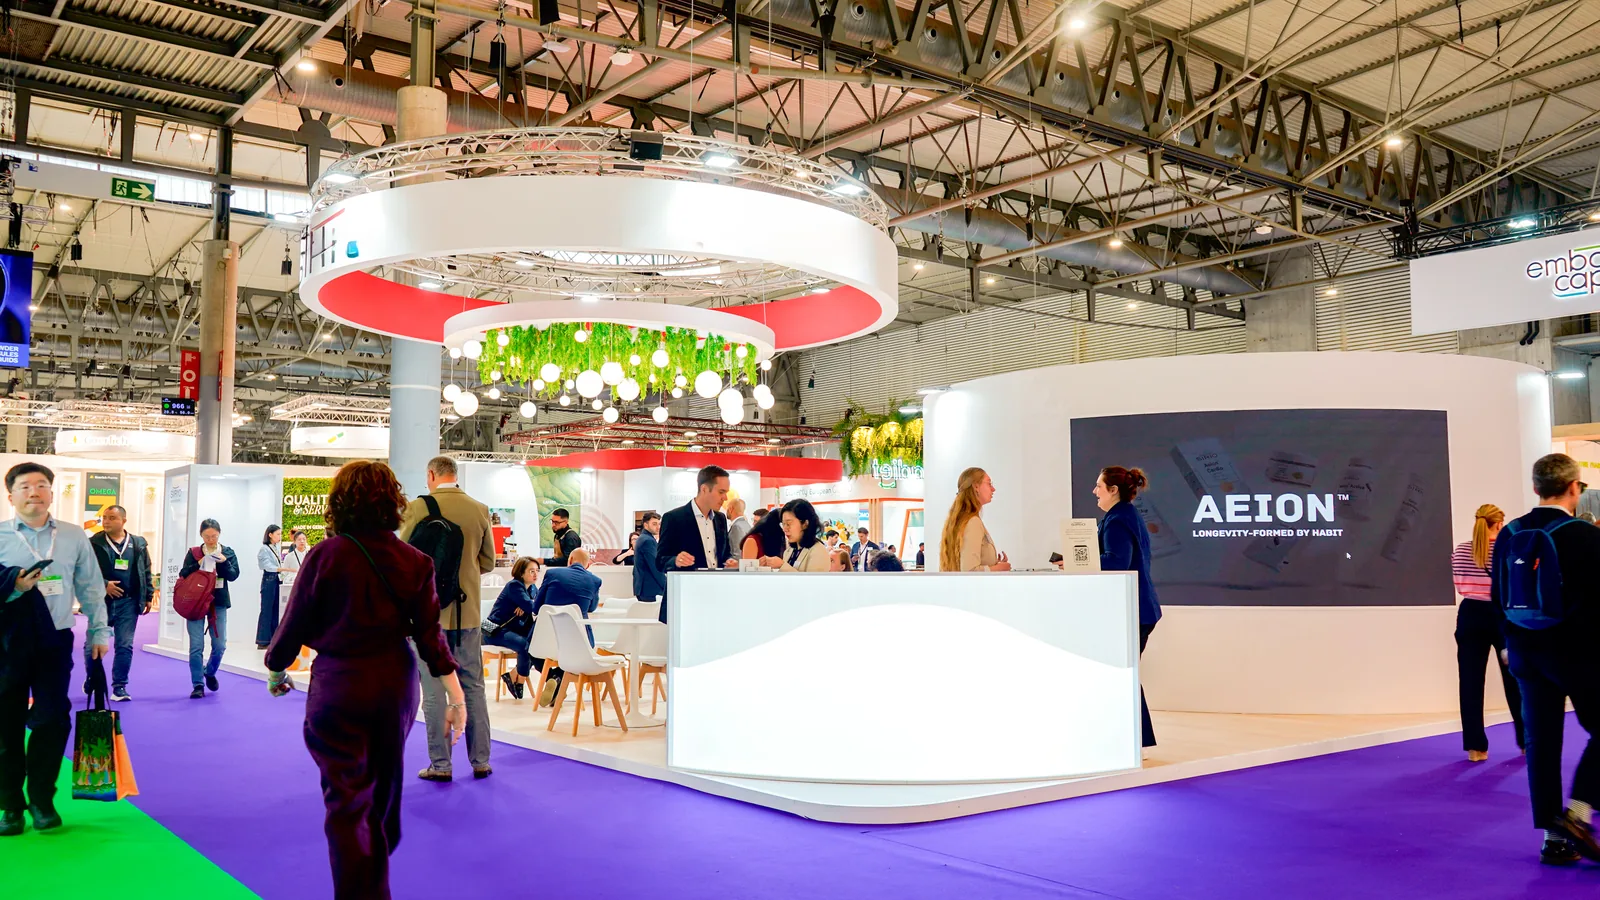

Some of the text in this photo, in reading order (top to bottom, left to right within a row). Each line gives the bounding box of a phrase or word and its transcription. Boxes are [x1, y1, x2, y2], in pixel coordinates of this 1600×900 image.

[89, 487, 117, 495] OMEGA
[283, 494, 330, 506] QUALIT
[293, 504, 329, 515] & SERV
[1192, 529, 1344, 537] LONGEVITY-FORMED BY HABIT
